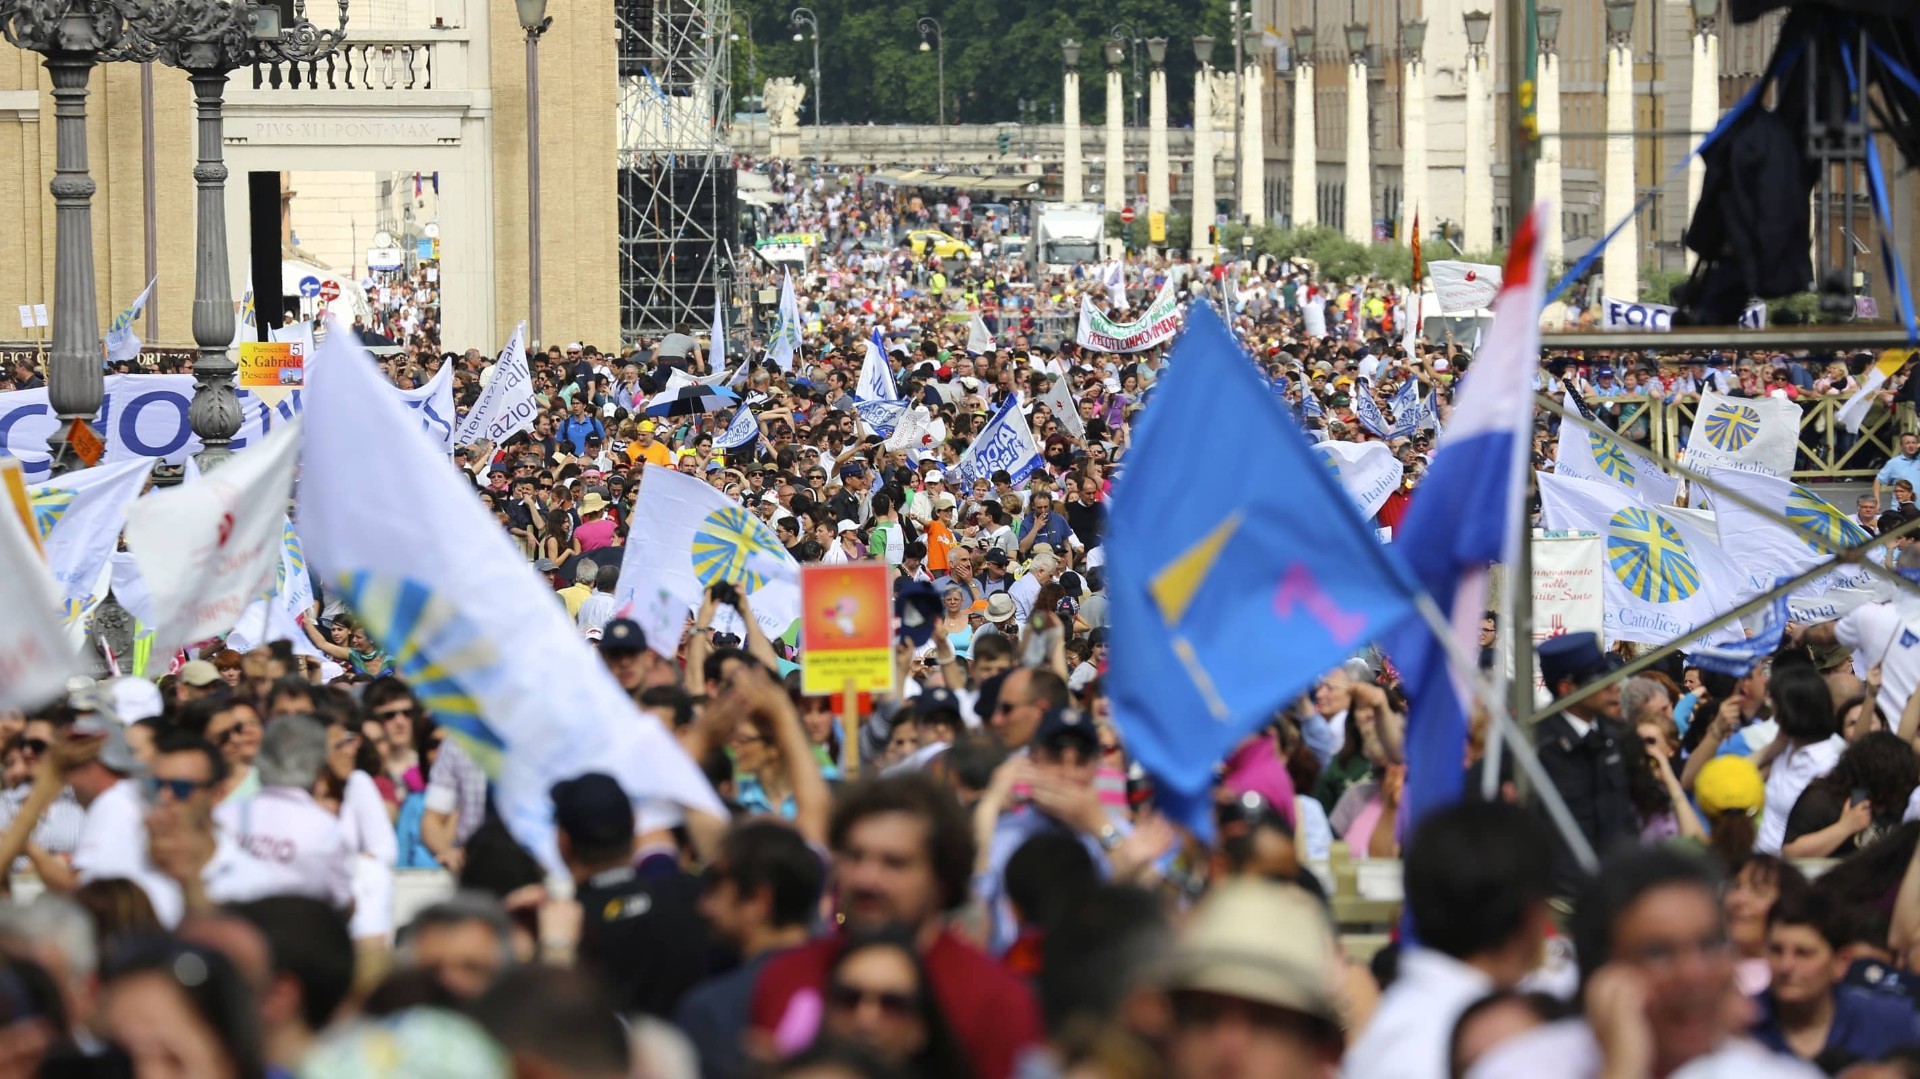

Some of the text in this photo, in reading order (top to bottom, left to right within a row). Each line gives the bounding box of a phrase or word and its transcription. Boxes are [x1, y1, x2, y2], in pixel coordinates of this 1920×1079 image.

[292, 343, 301, 356] 5
[240, 355, 303, 368] S. Gabriele
[241, 371, 279, 380] Pescara
[1618, 607, 1682, 635] Cattolica
